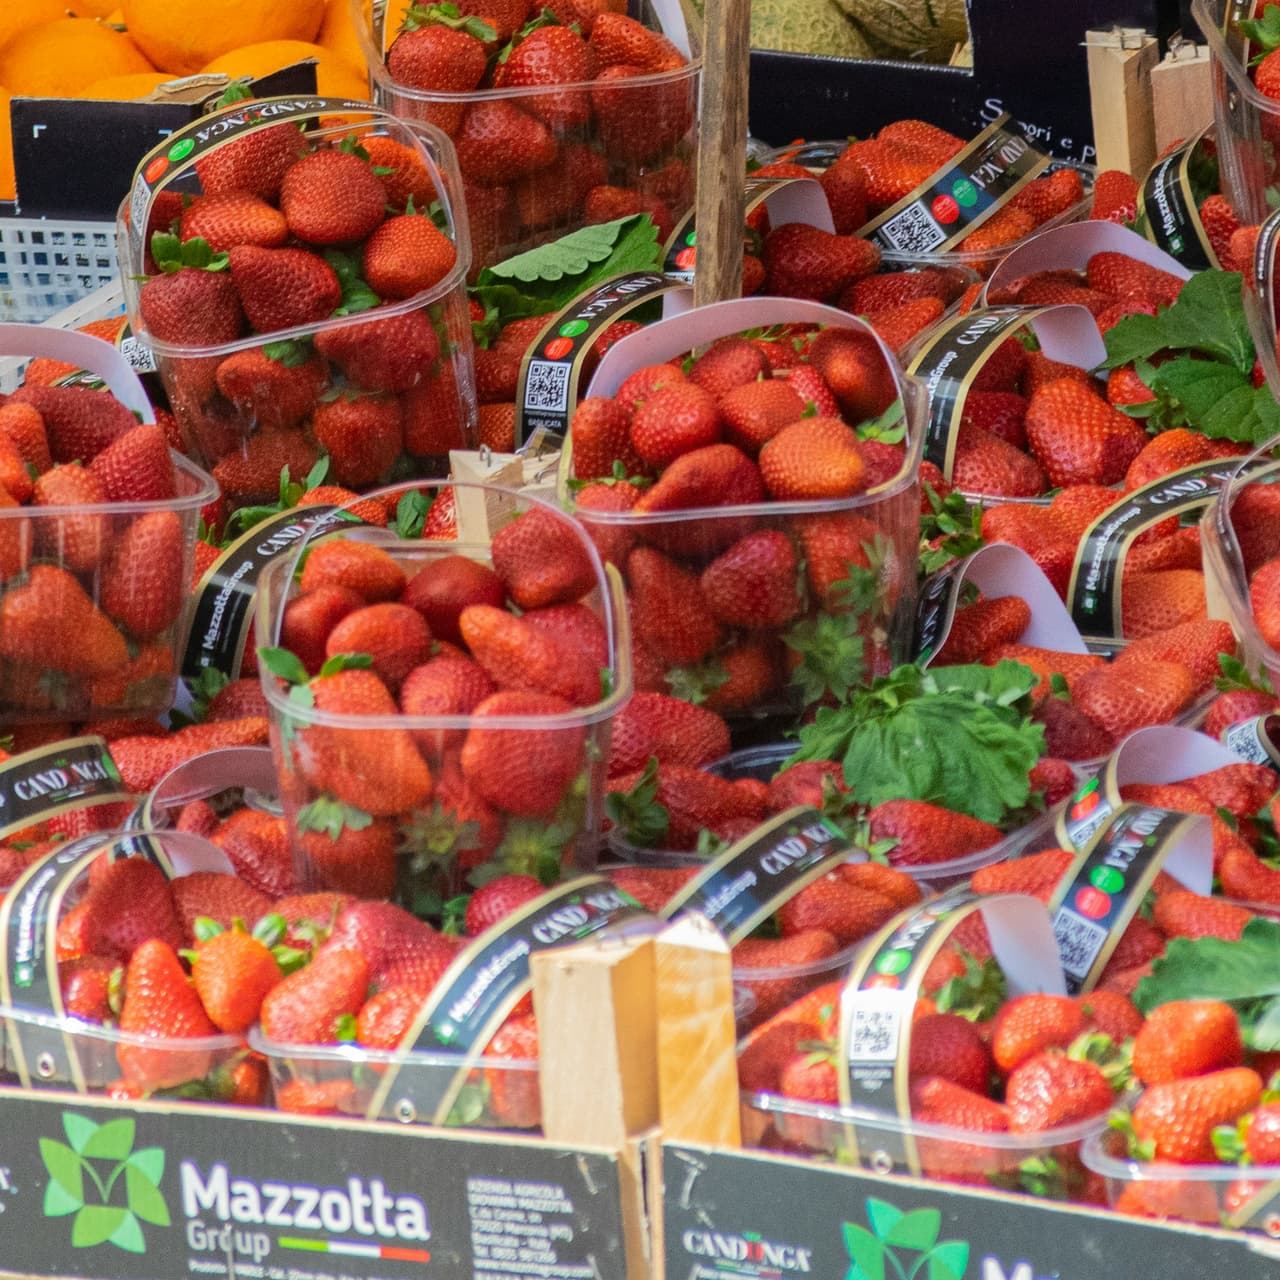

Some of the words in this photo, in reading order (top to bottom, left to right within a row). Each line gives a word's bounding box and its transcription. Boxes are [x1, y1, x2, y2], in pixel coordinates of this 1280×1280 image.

[1085, 506, 1143, 591] MazzottaGroup
[202, 560, 254, 651] MazzottaGroup
[180, 1161, 432, 1241] Mazzotta
[186, 1220, 271, 1264] Group
[682, 1230, 813, 1272] CANDONGA
